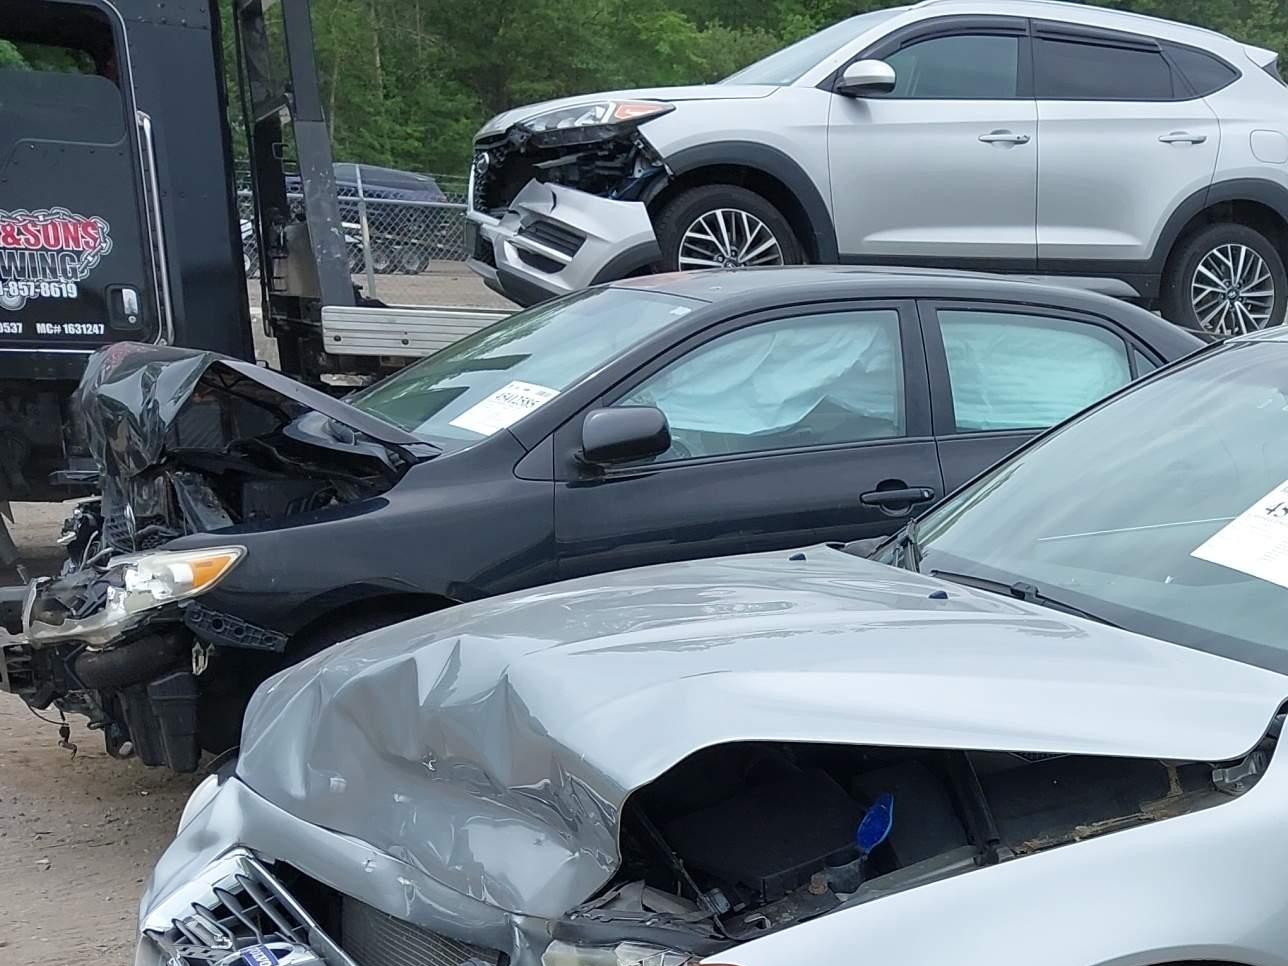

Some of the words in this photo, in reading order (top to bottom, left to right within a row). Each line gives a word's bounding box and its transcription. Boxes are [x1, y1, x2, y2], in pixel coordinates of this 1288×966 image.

[0, 219, 98, 250] &SONS
[36, 322, 60, 335] MC#
[63, 323, 105, 335] 1631247
